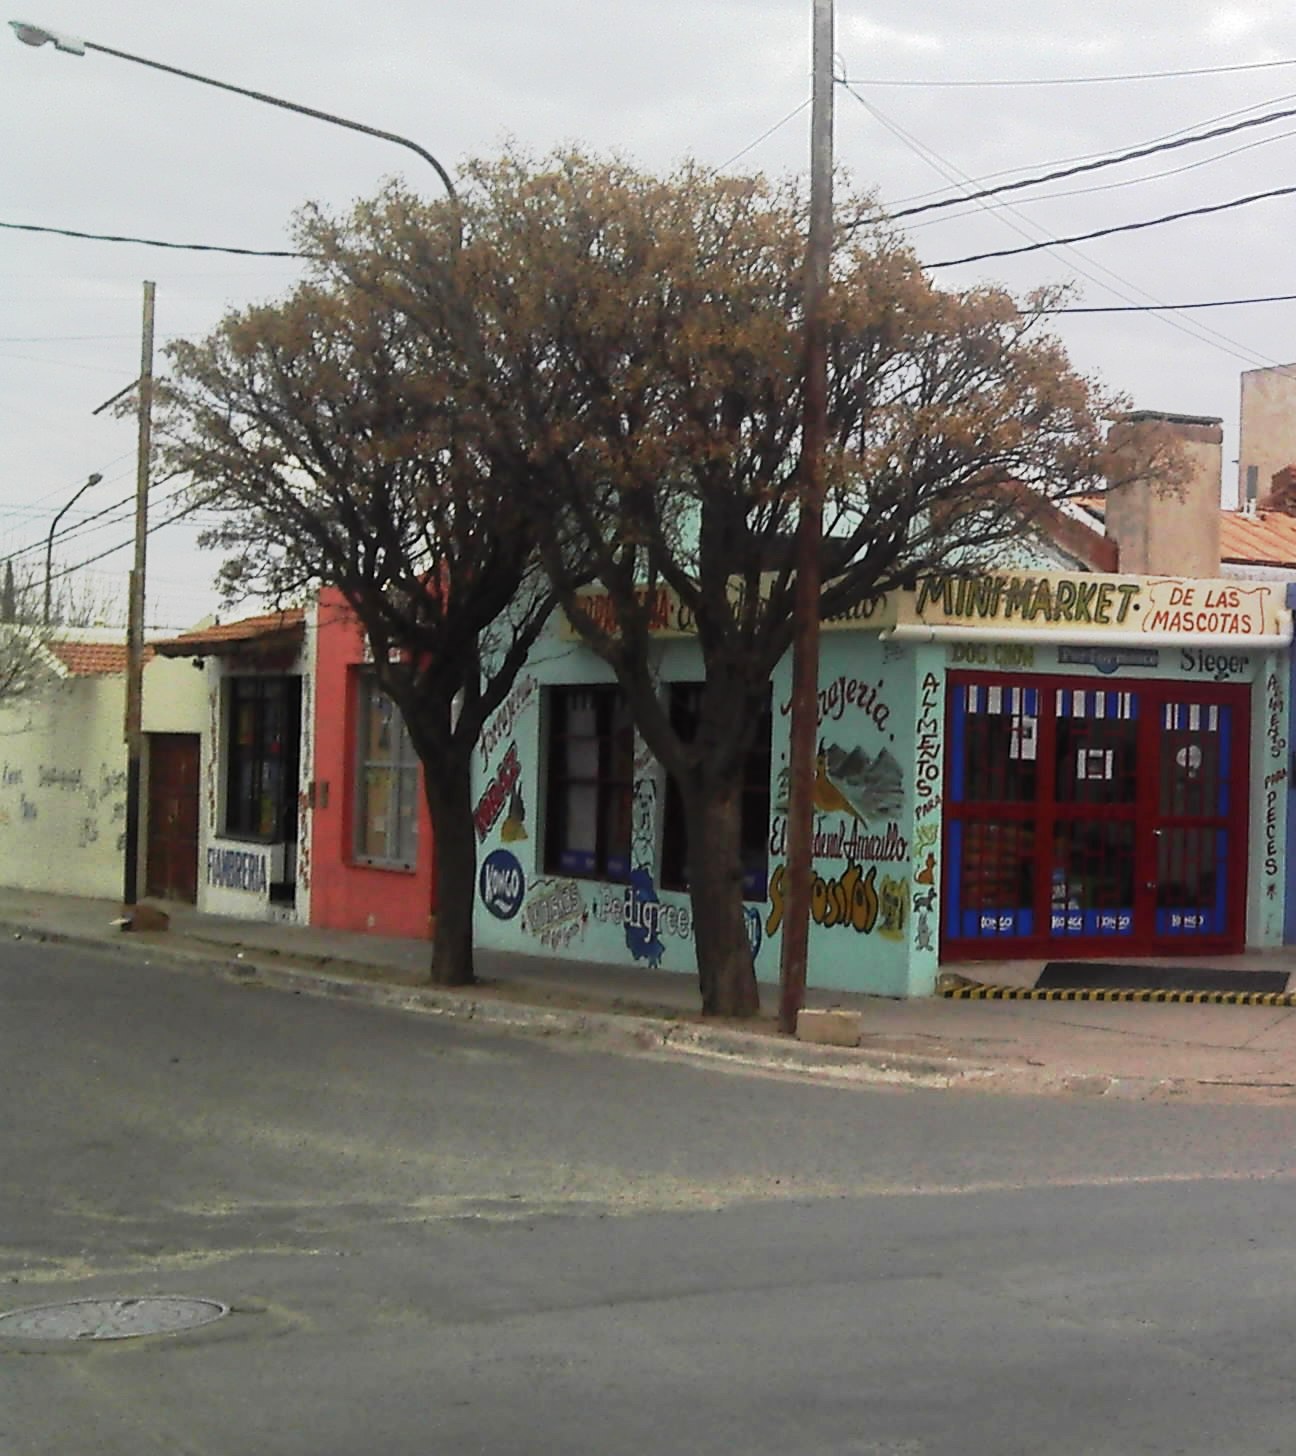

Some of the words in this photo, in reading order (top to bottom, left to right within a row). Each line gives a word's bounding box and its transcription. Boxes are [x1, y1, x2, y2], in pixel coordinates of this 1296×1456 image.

[1169, 587, 1196, 606] DE
[1204, 590, 1240, 608] LAS
[1150, 610, 1252, 634] MASCOTAS
[1181, 647, 1249, 681] Sieger
[916, 671, 940, 797] ALIMENTOS
[915, 795, 943, 821] PARA
[770, 816, 786, 856] El
[1265, 792, 1277, 876] PECES
